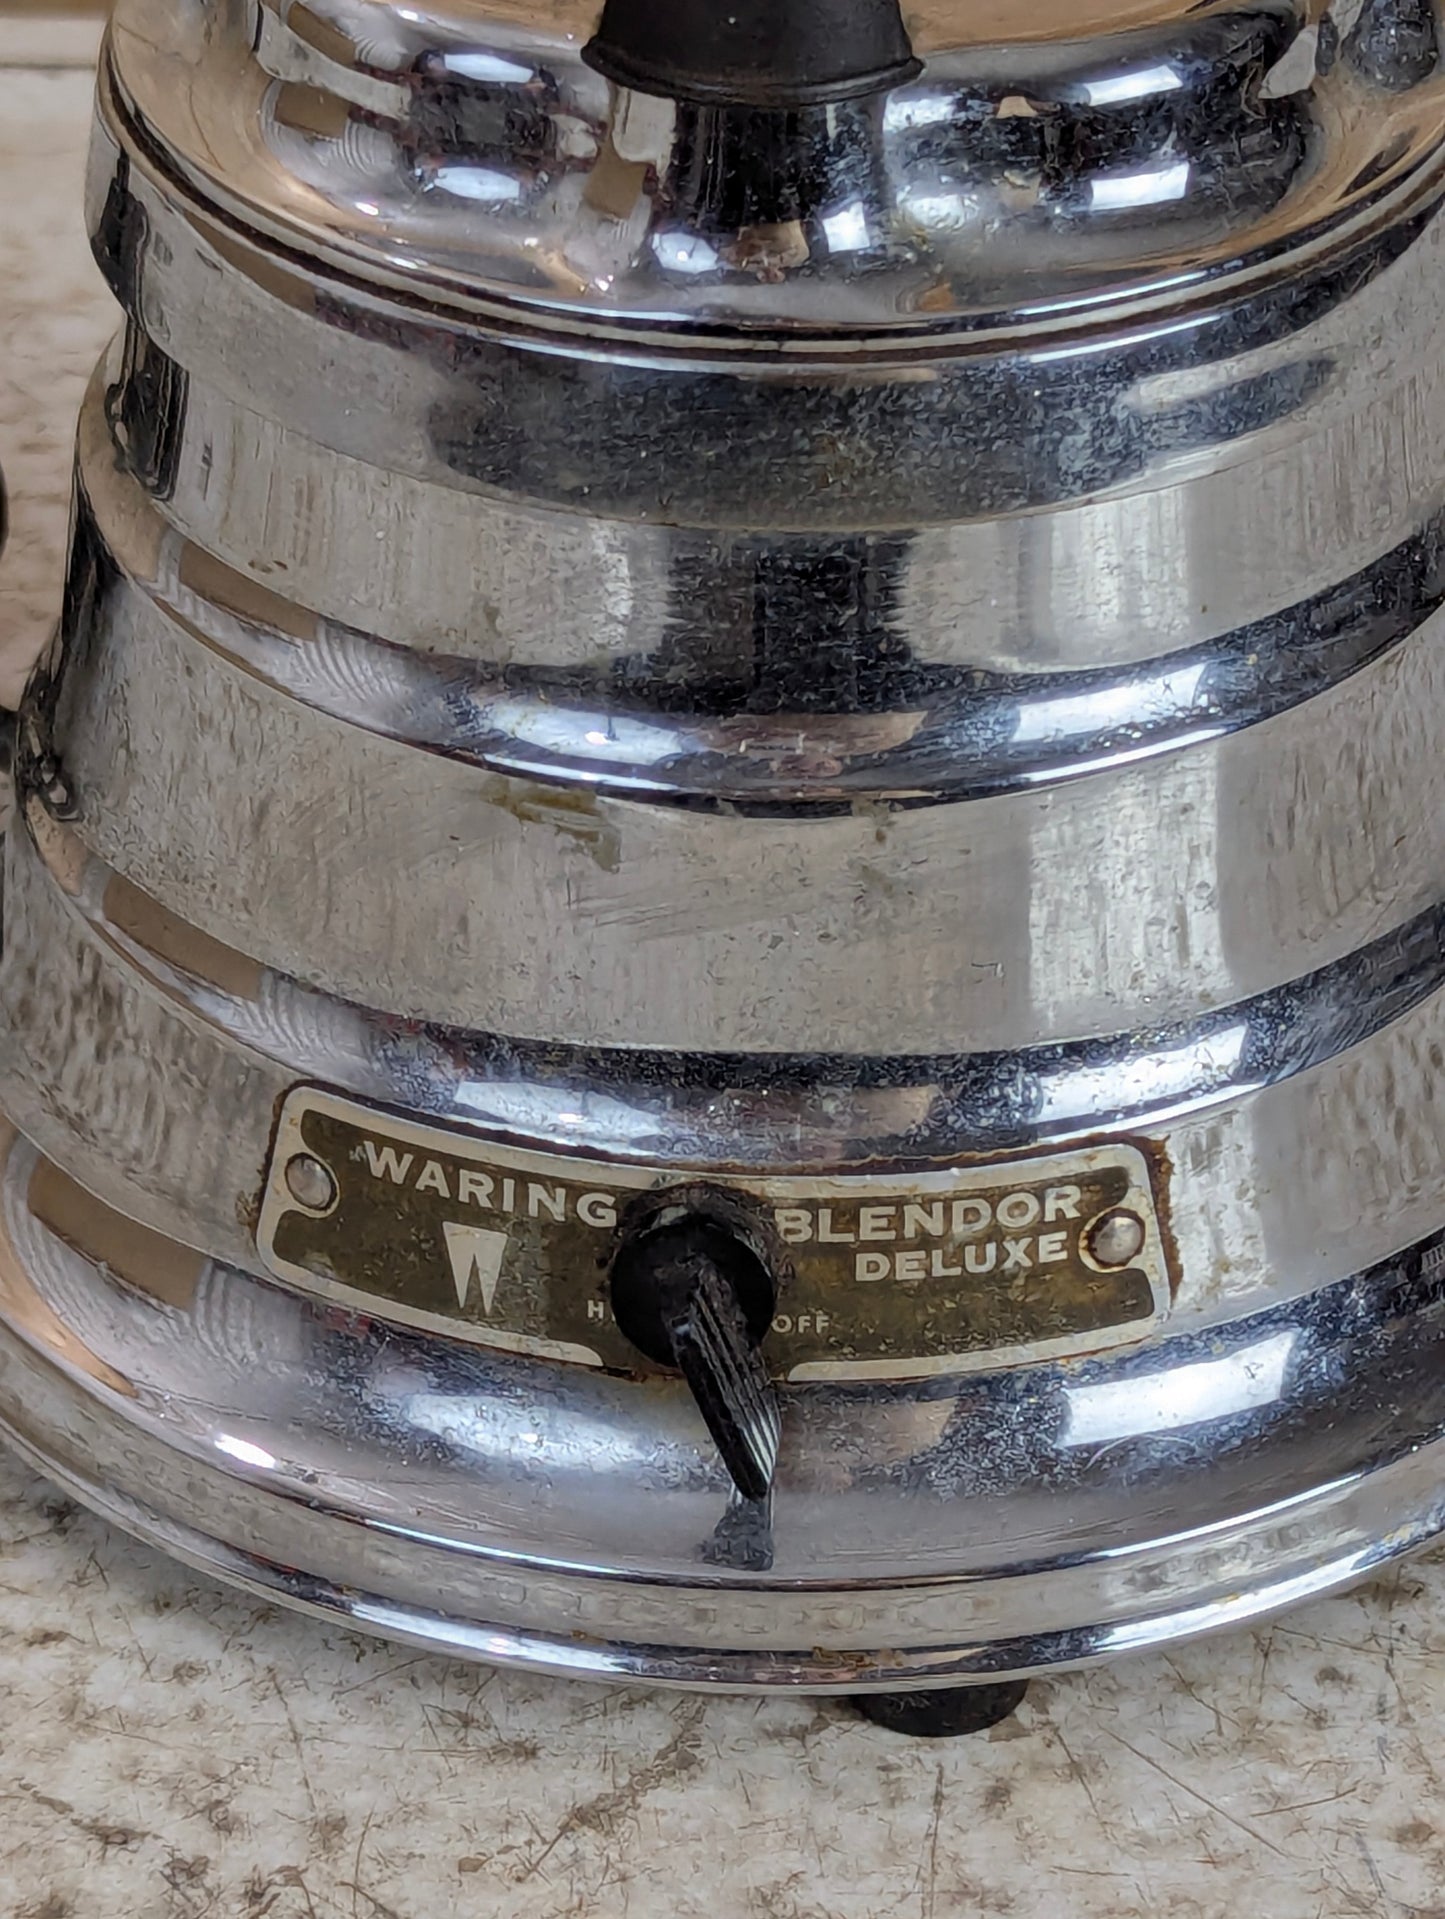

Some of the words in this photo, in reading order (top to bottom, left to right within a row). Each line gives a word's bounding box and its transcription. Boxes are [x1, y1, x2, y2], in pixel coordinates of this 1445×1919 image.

[364, 1140, 617, 1228] WARING
[774, 1185, 1081, 1243] BLENDOR
[855, 1231, 1069, 1282] DELUXE
[771, 1314, 830, 1335] OFF
